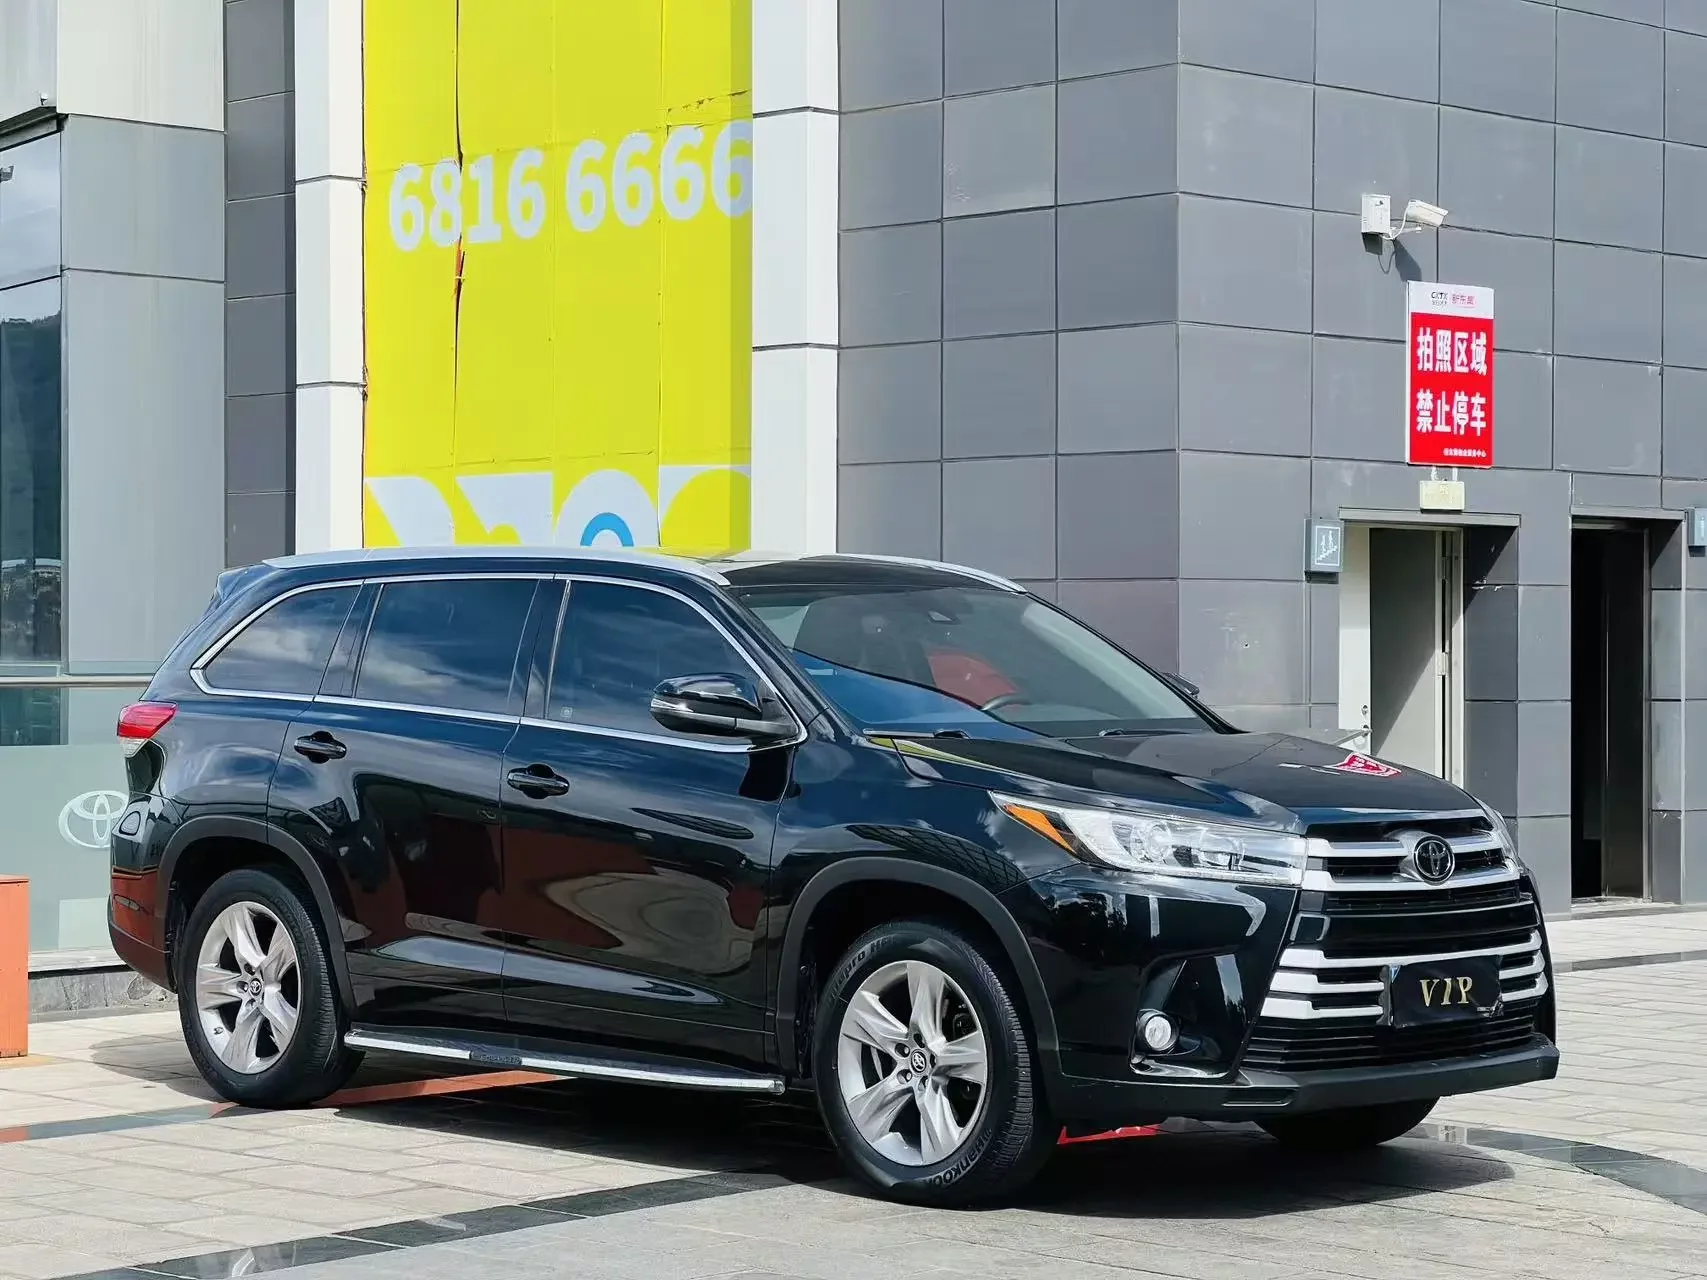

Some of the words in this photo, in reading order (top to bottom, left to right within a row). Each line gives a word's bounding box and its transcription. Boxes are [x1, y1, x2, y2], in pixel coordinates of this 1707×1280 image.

[389, 147, 546, 252] 6816
[565, 119, 752, 232] 6666
[1416, 326, 1488, 375] 拍照区域
[1416, 388, 1487, 437] 禁止停车
[1419, 976, 1473, 1007] VIP
